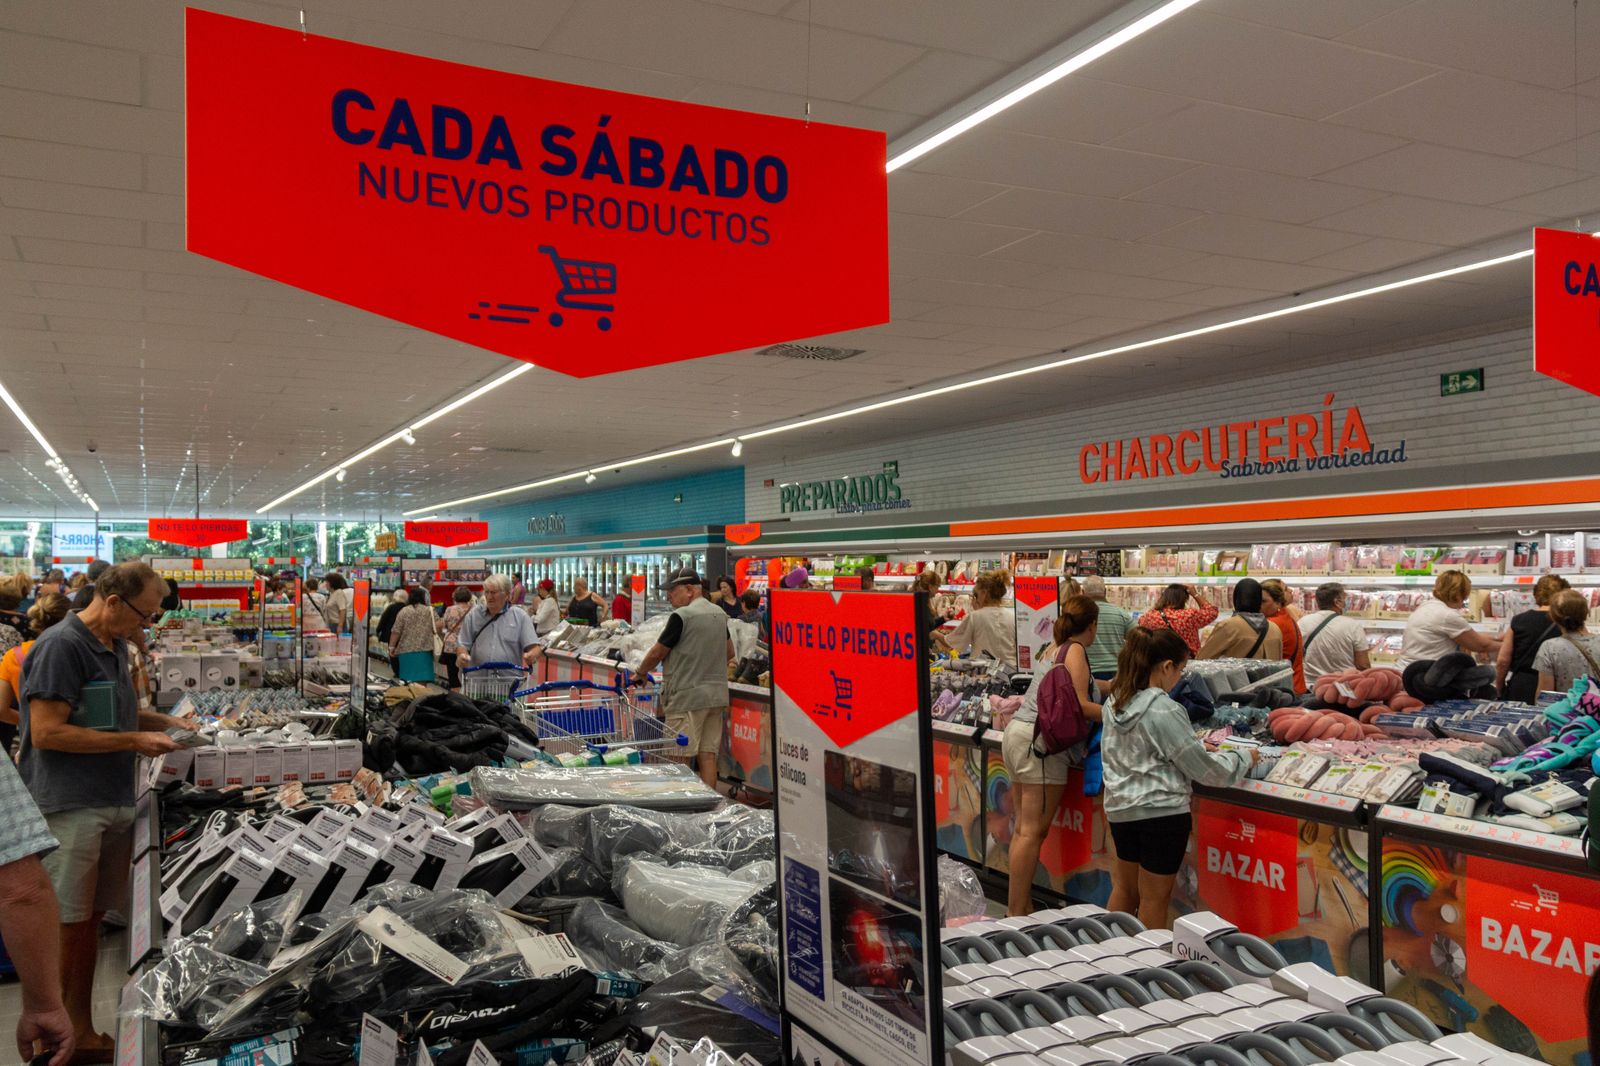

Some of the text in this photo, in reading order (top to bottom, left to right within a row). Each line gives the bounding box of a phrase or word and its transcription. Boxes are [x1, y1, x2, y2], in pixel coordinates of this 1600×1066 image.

[331, 88, 789, 204] CADA SÁBADO
[357, 161, 770, 247] NUEVOS PRODUCTOS
[1079, 392, 1372, 485] CHARCUTERÍA
[1220, 440, 1408, 479] Sabrosa variedad
[780, 472, 901, 514] PREPARADOS
[173, 523, 183, 531] TE
[775, 621, 915, 660] NO TE LO PIERDAS
[734, 723, 757, 743] BAZAR
[779, 737, 809, 762] Luces de
[779, 762, 806, 786] silicona
[1207, 846, 1286, 892] BAZAR
